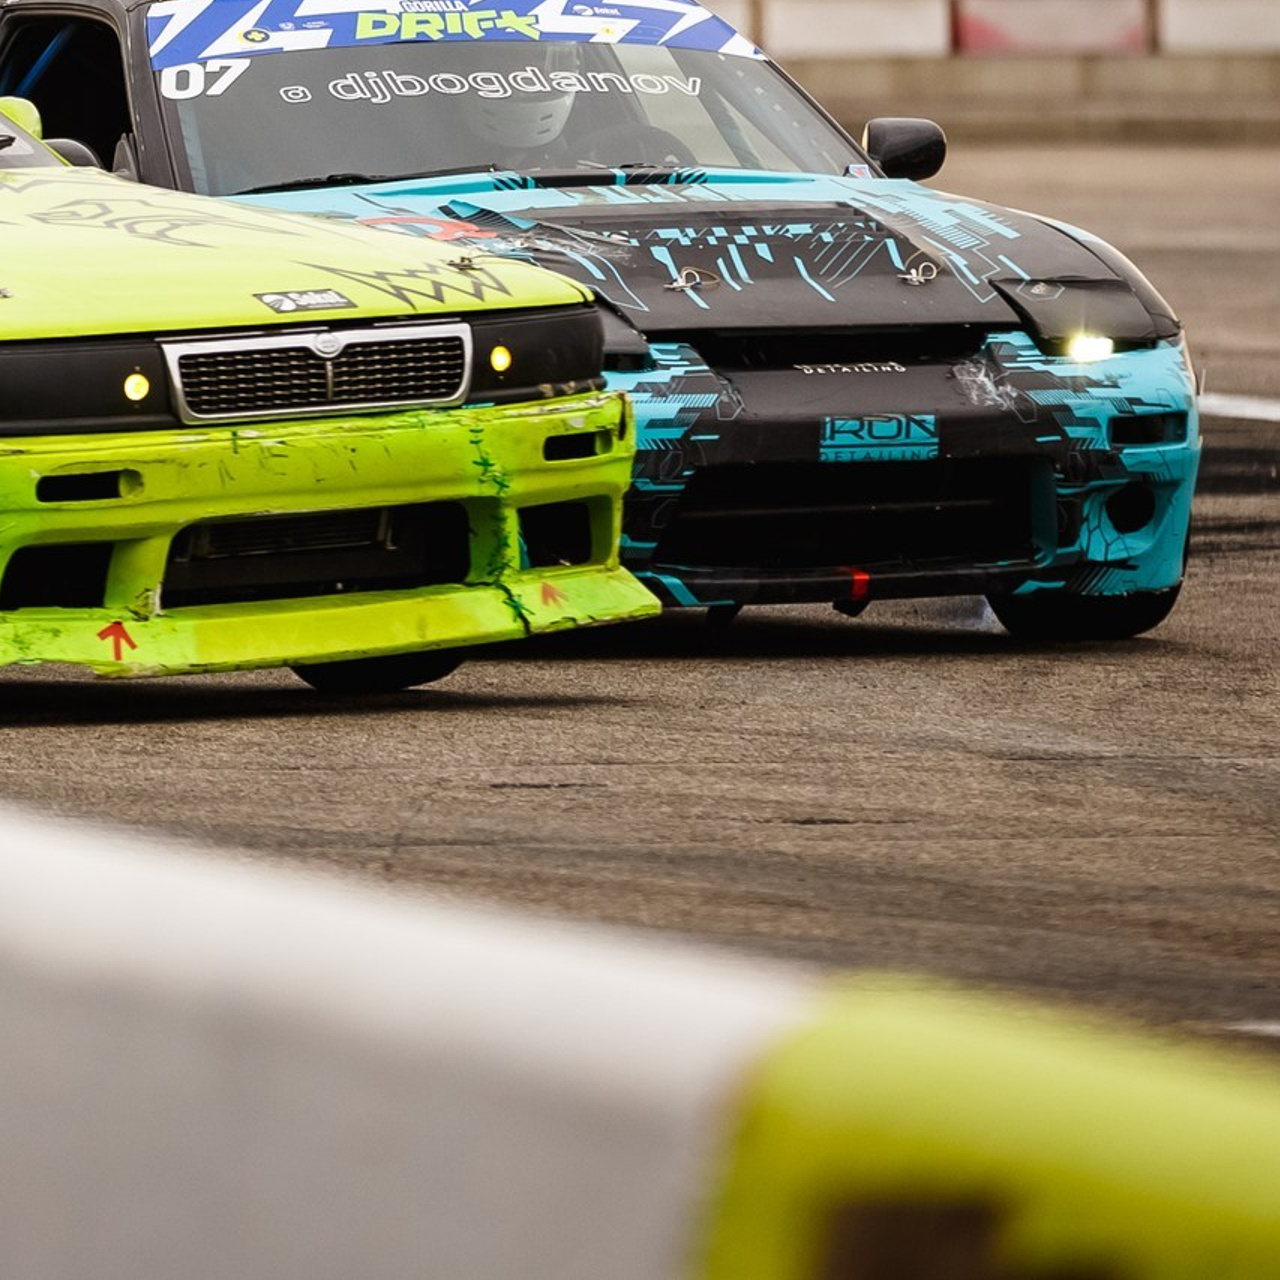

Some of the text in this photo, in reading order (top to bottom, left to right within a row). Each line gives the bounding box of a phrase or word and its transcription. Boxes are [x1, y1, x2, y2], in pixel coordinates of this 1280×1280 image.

[401, 0, 469, 13] GORILLA
[161, 58, 251, 100] 07
[328, 66, 702, 104] djbogdanov
